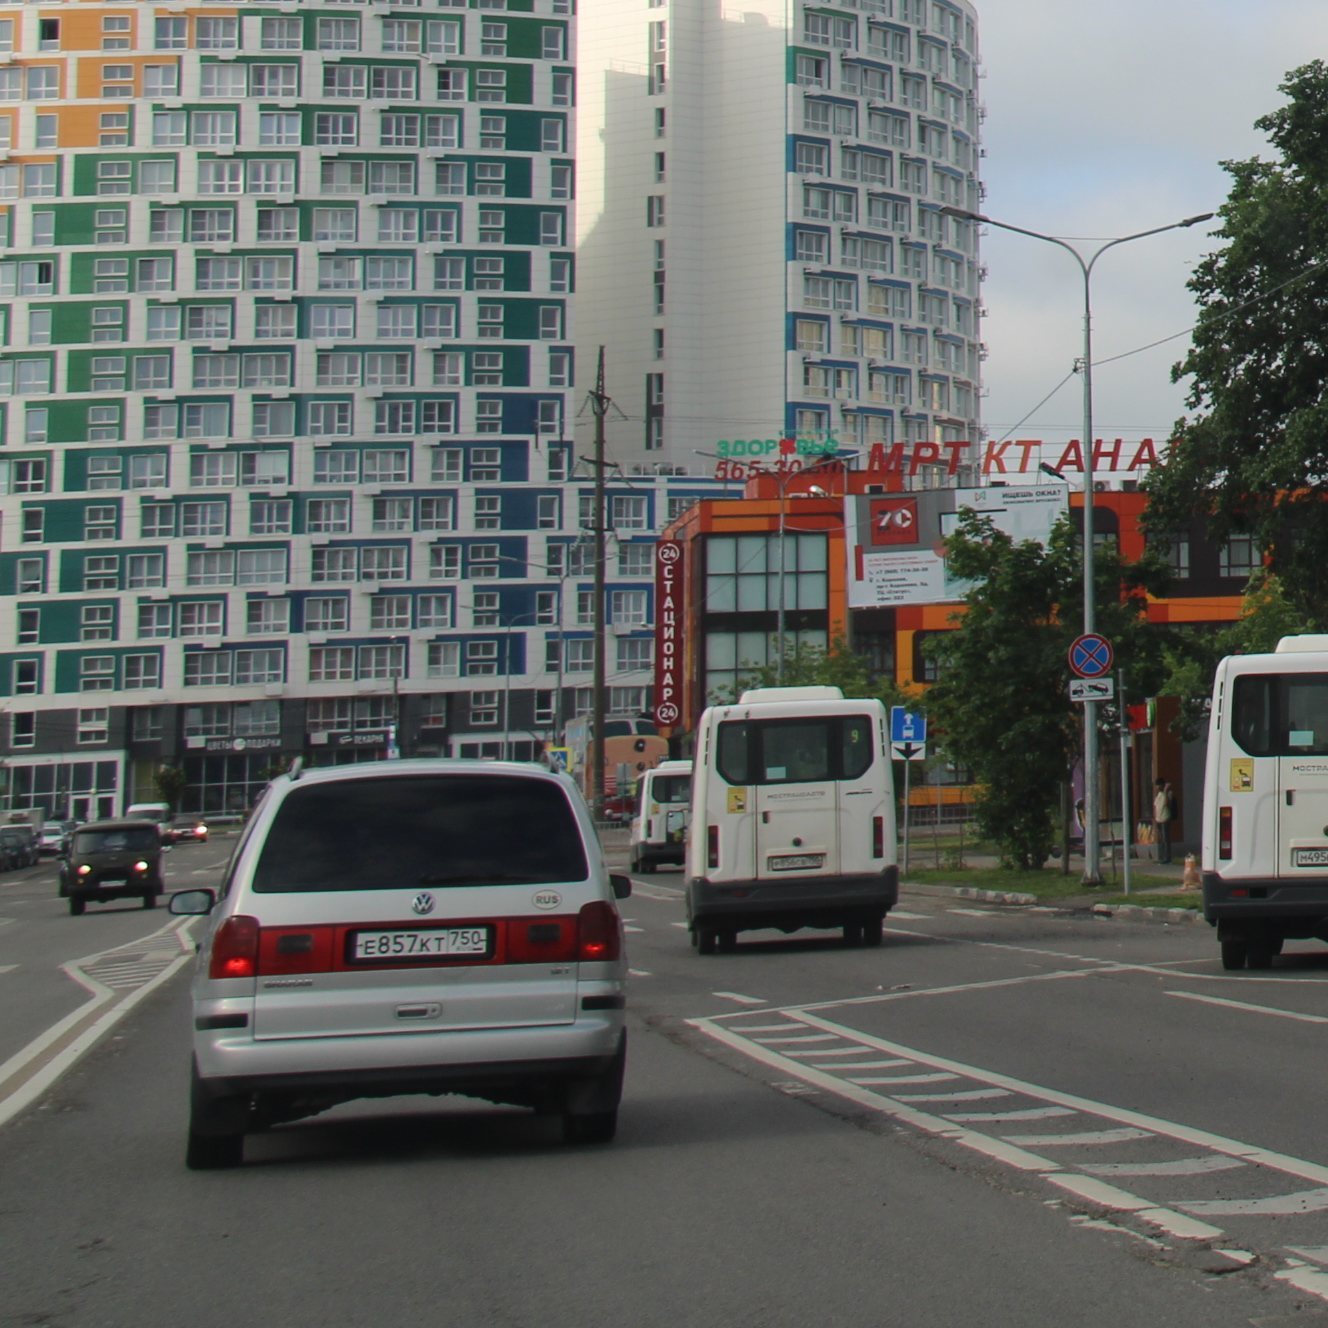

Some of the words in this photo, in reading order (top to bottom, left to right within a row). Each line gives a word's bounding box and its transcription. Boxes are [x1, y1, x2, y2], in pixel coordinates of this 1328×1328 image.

[866, 440, 971, 476] МРТ
[981, 440, 1042, 475] КТ
[1055, 438, 1182, 473] АНА
[663, 548, 676, 559] 24
[662, 565, 675, 701] СТАЦИОНАР
[661, 707, 675, 718] 24
[535, 895, 559, 904] RUS
[364, 934, 445, 955] Е857КТ
[450, 930, 481, 946] 750
